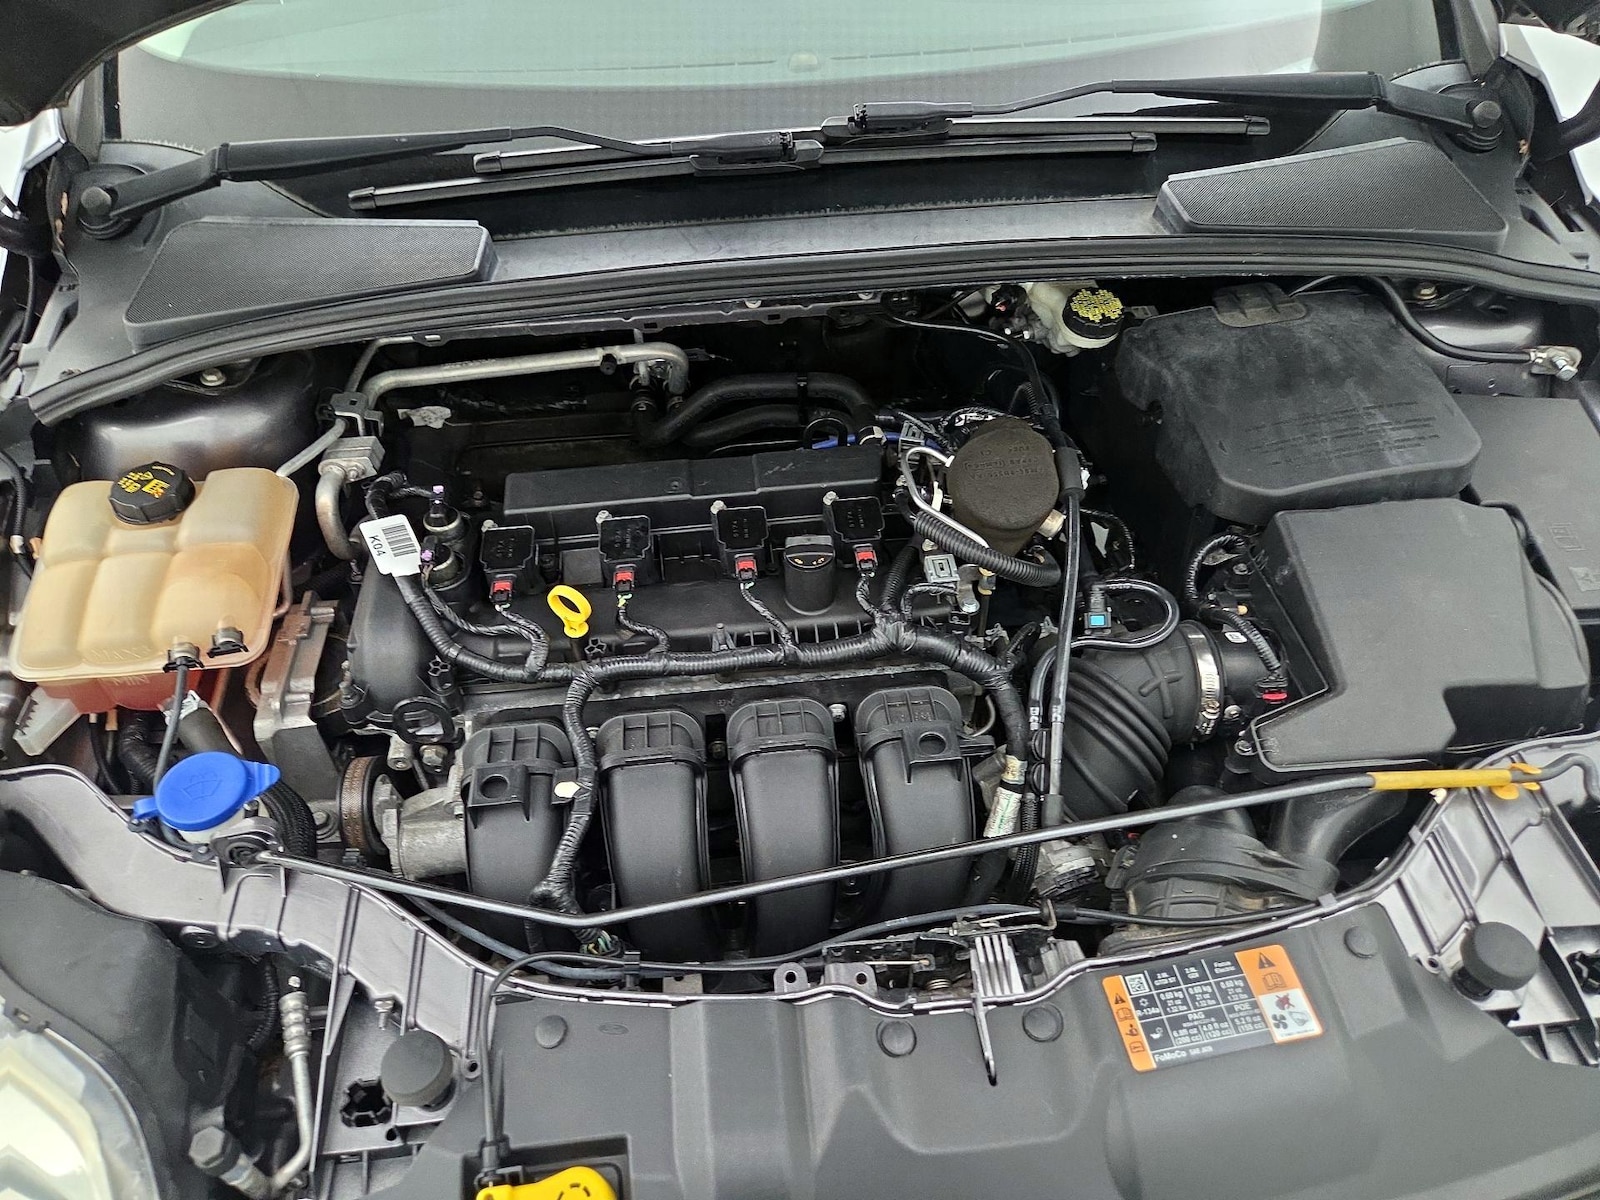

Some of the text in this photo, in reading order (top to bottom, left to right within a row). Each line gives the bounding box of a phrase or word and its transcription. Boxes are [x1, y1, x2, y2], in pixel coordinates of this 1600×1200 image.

[369, 535, 386, 557] K04
[1219, 979, 1244, 989] 0.60 kg
[1159, 990, 1185, 1000] 0.60 kg
[1187, 985, 1212, 995] 0.60 kg
[1135, 1006, 1160, 1017] R-134a
[1233, 1002, 1252, 1012] POE
[1187, 1011, 1205, 1020] PAG
[1154, 1050, 1187, 1062] FoMoCo
